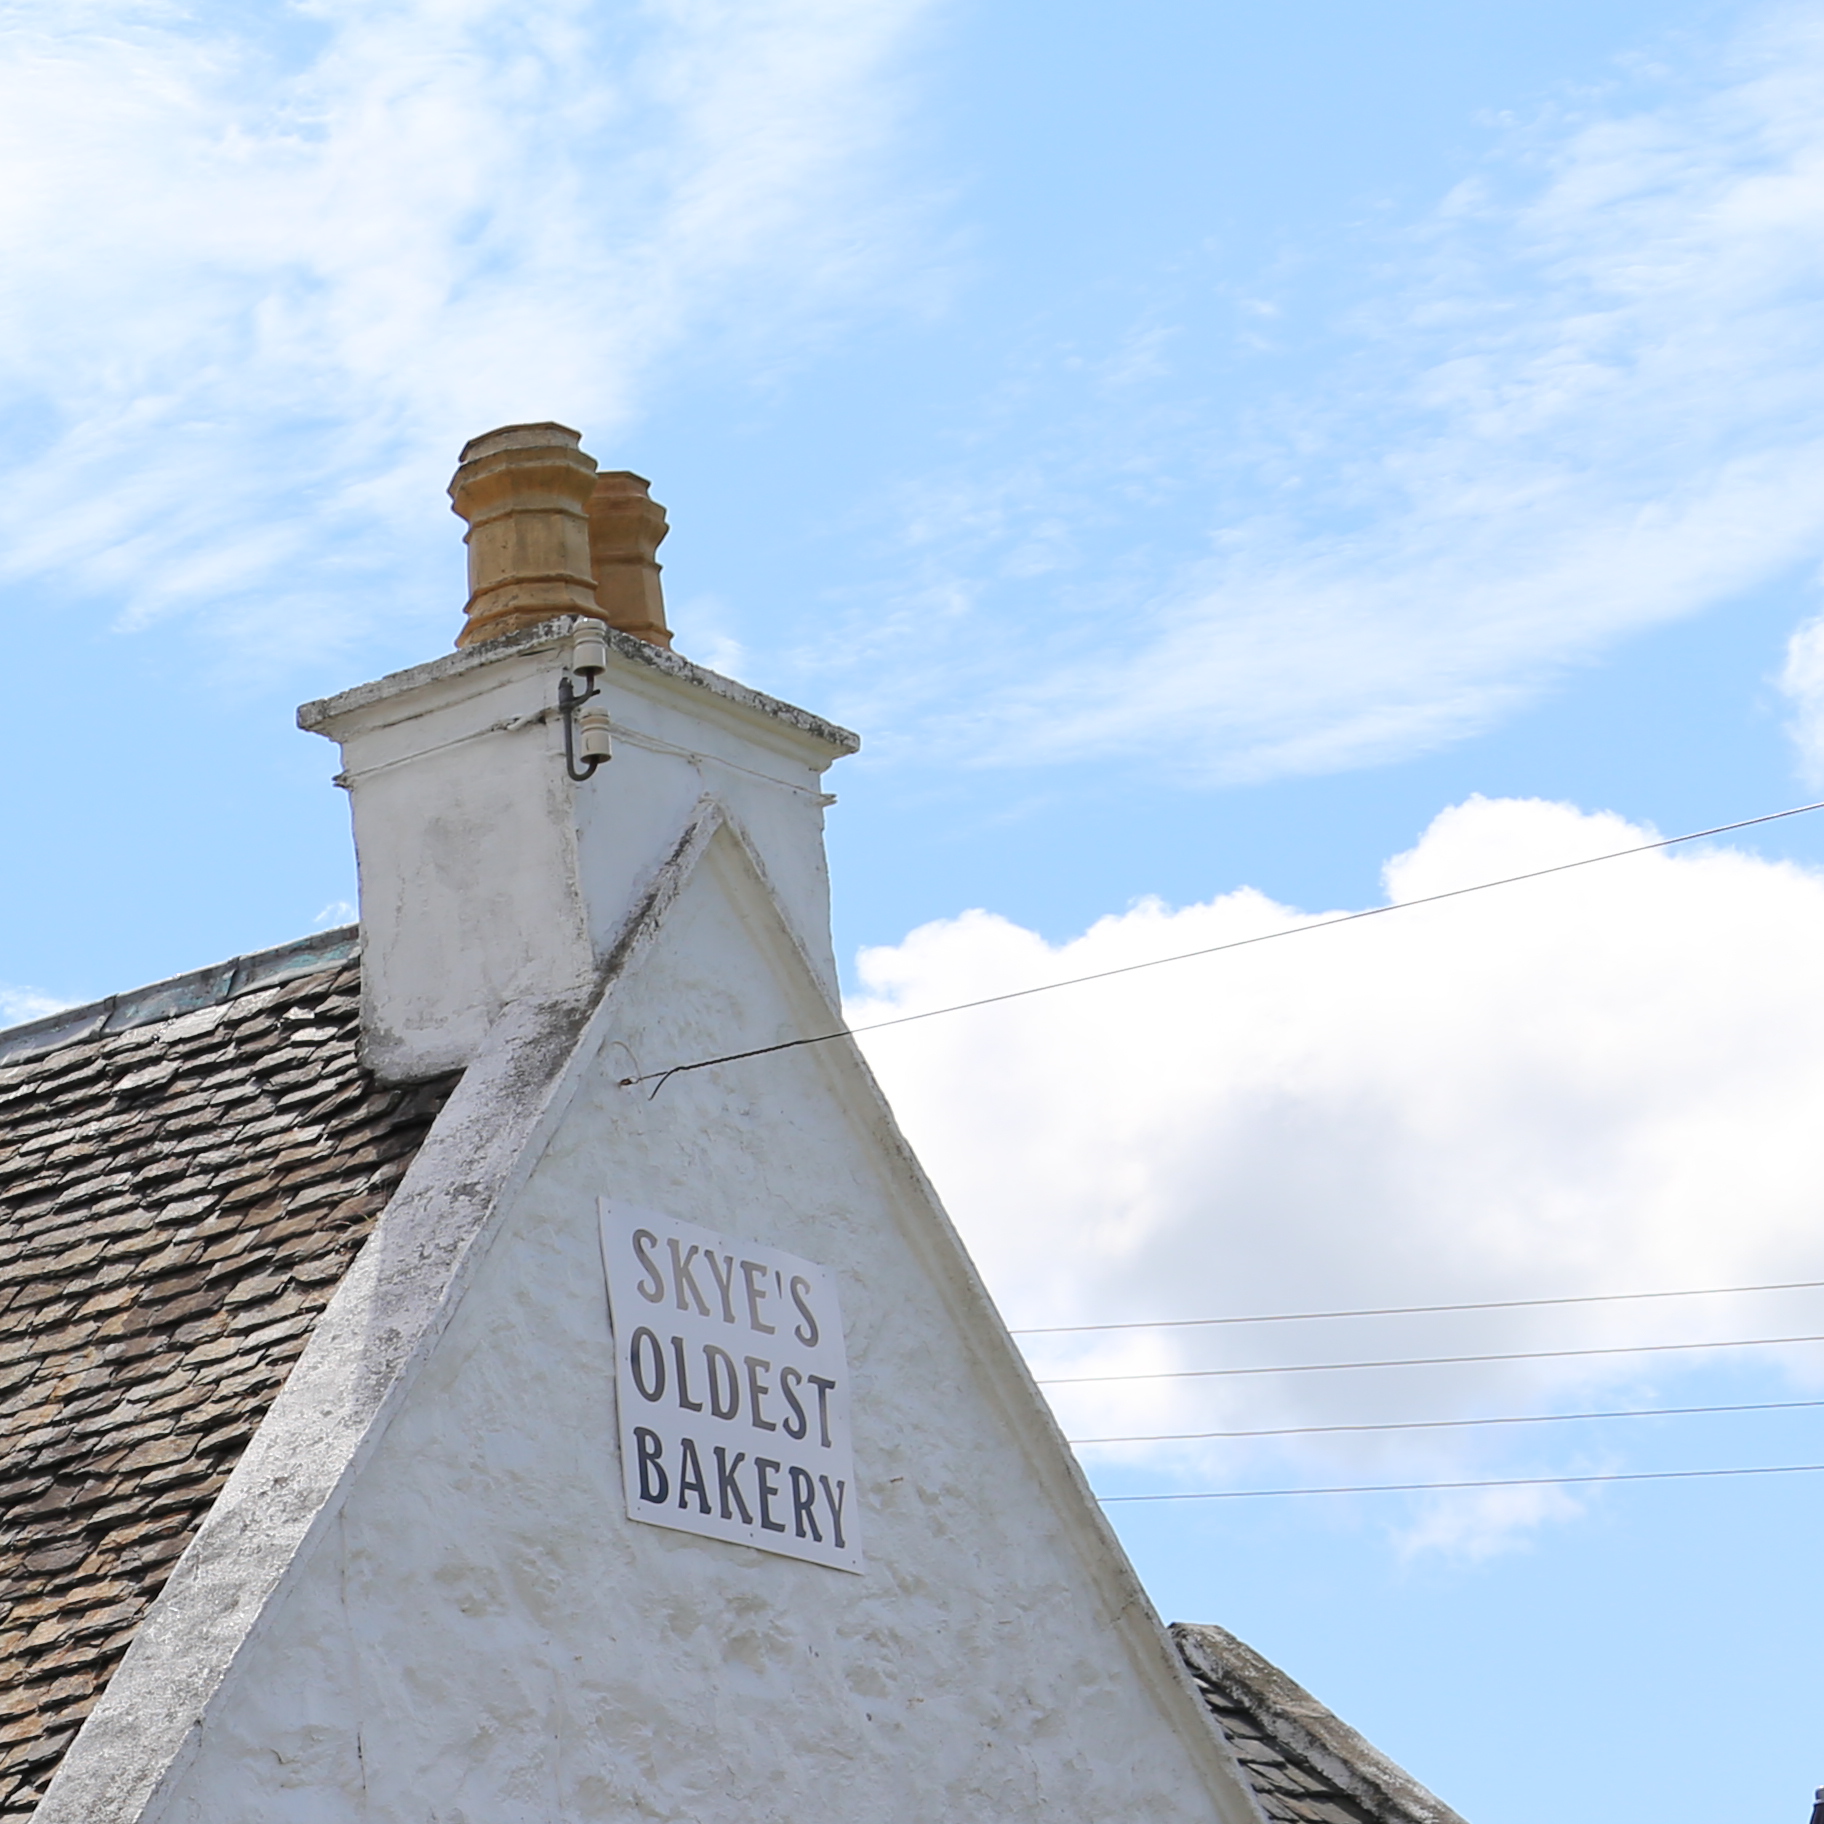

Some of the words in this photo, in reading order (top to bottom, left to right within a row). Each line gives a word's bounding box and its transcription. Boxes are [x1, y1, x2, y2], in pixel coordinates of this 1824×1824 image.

[632, 1229, 819, 1348] SKYE'S
[630, 1326, 836, 1448] OLDEST
[633, 1427, 845, 1549] BAKERY
